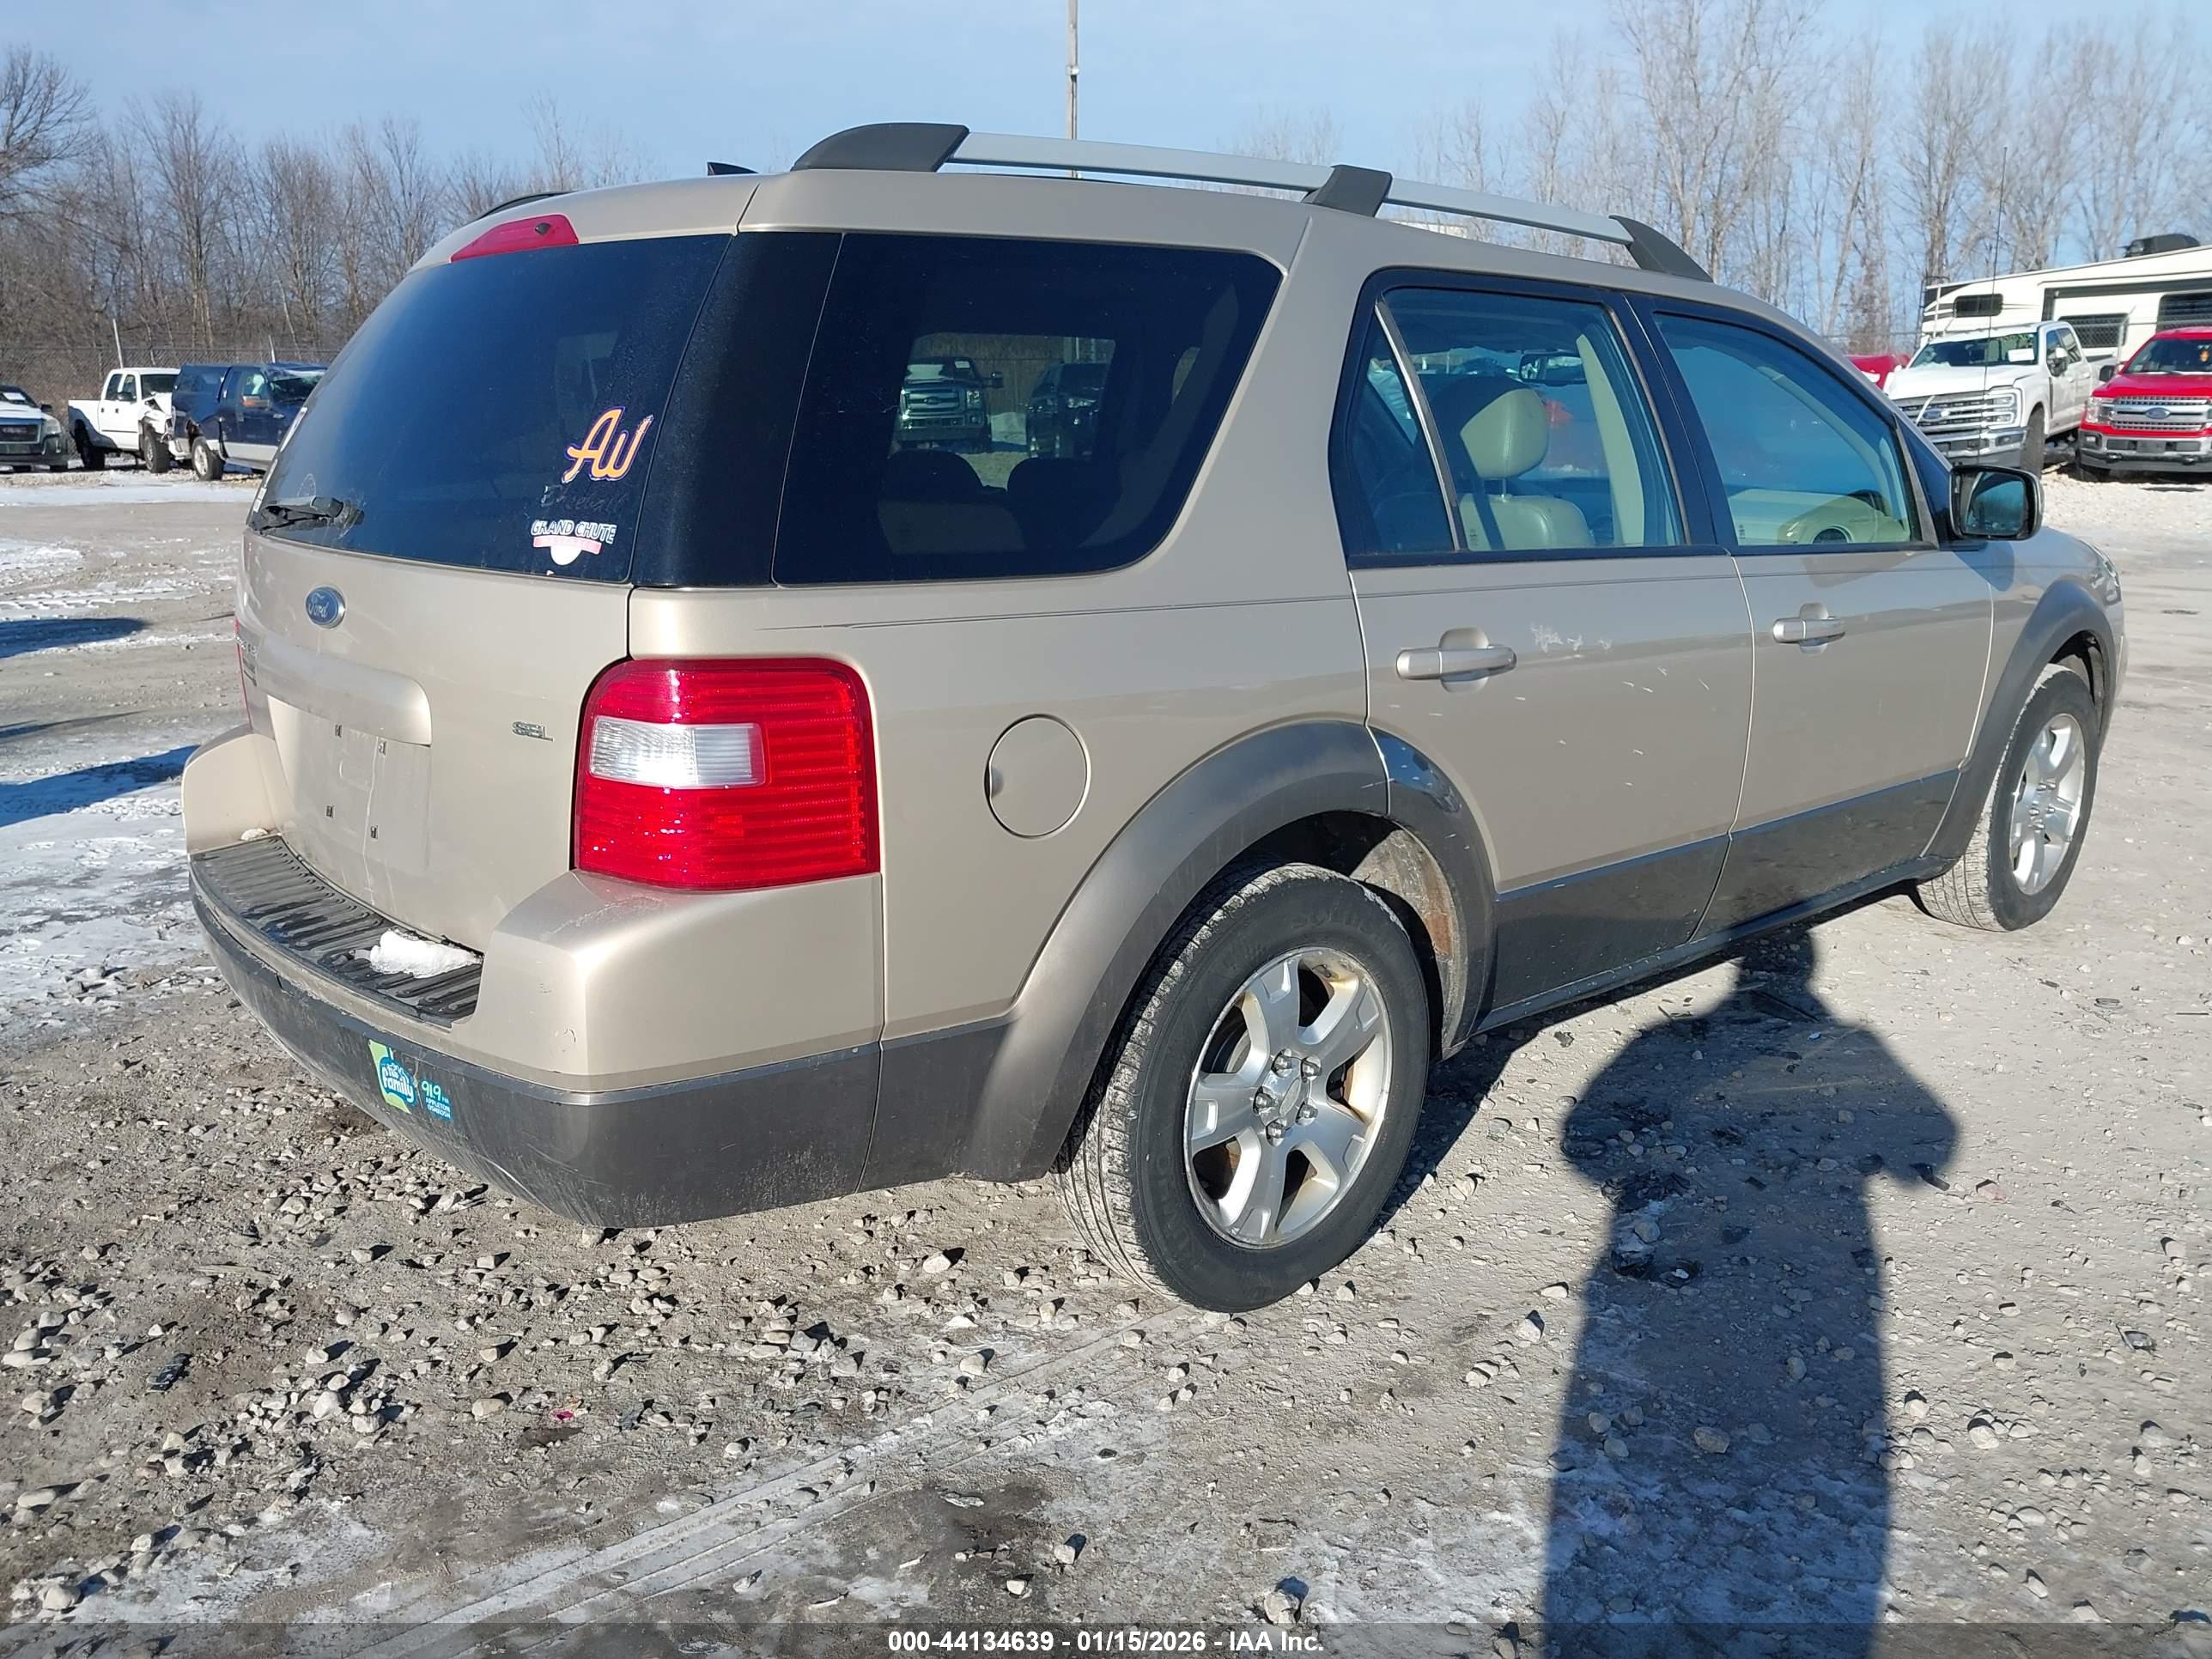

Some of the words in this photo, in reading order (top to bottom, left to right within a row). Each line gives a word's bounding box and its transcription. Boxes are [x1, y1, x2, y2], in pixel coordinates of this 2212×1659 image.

[562, 405, 654, 483] AW
[531, 520, 574, 536] GRAND
[574, 521, 617, 544] CHUTE
[308, 592, 330, 619] Ford
[513, 721, 554, 742] SEL
[422, 1080, 441, 1101] 91.9
